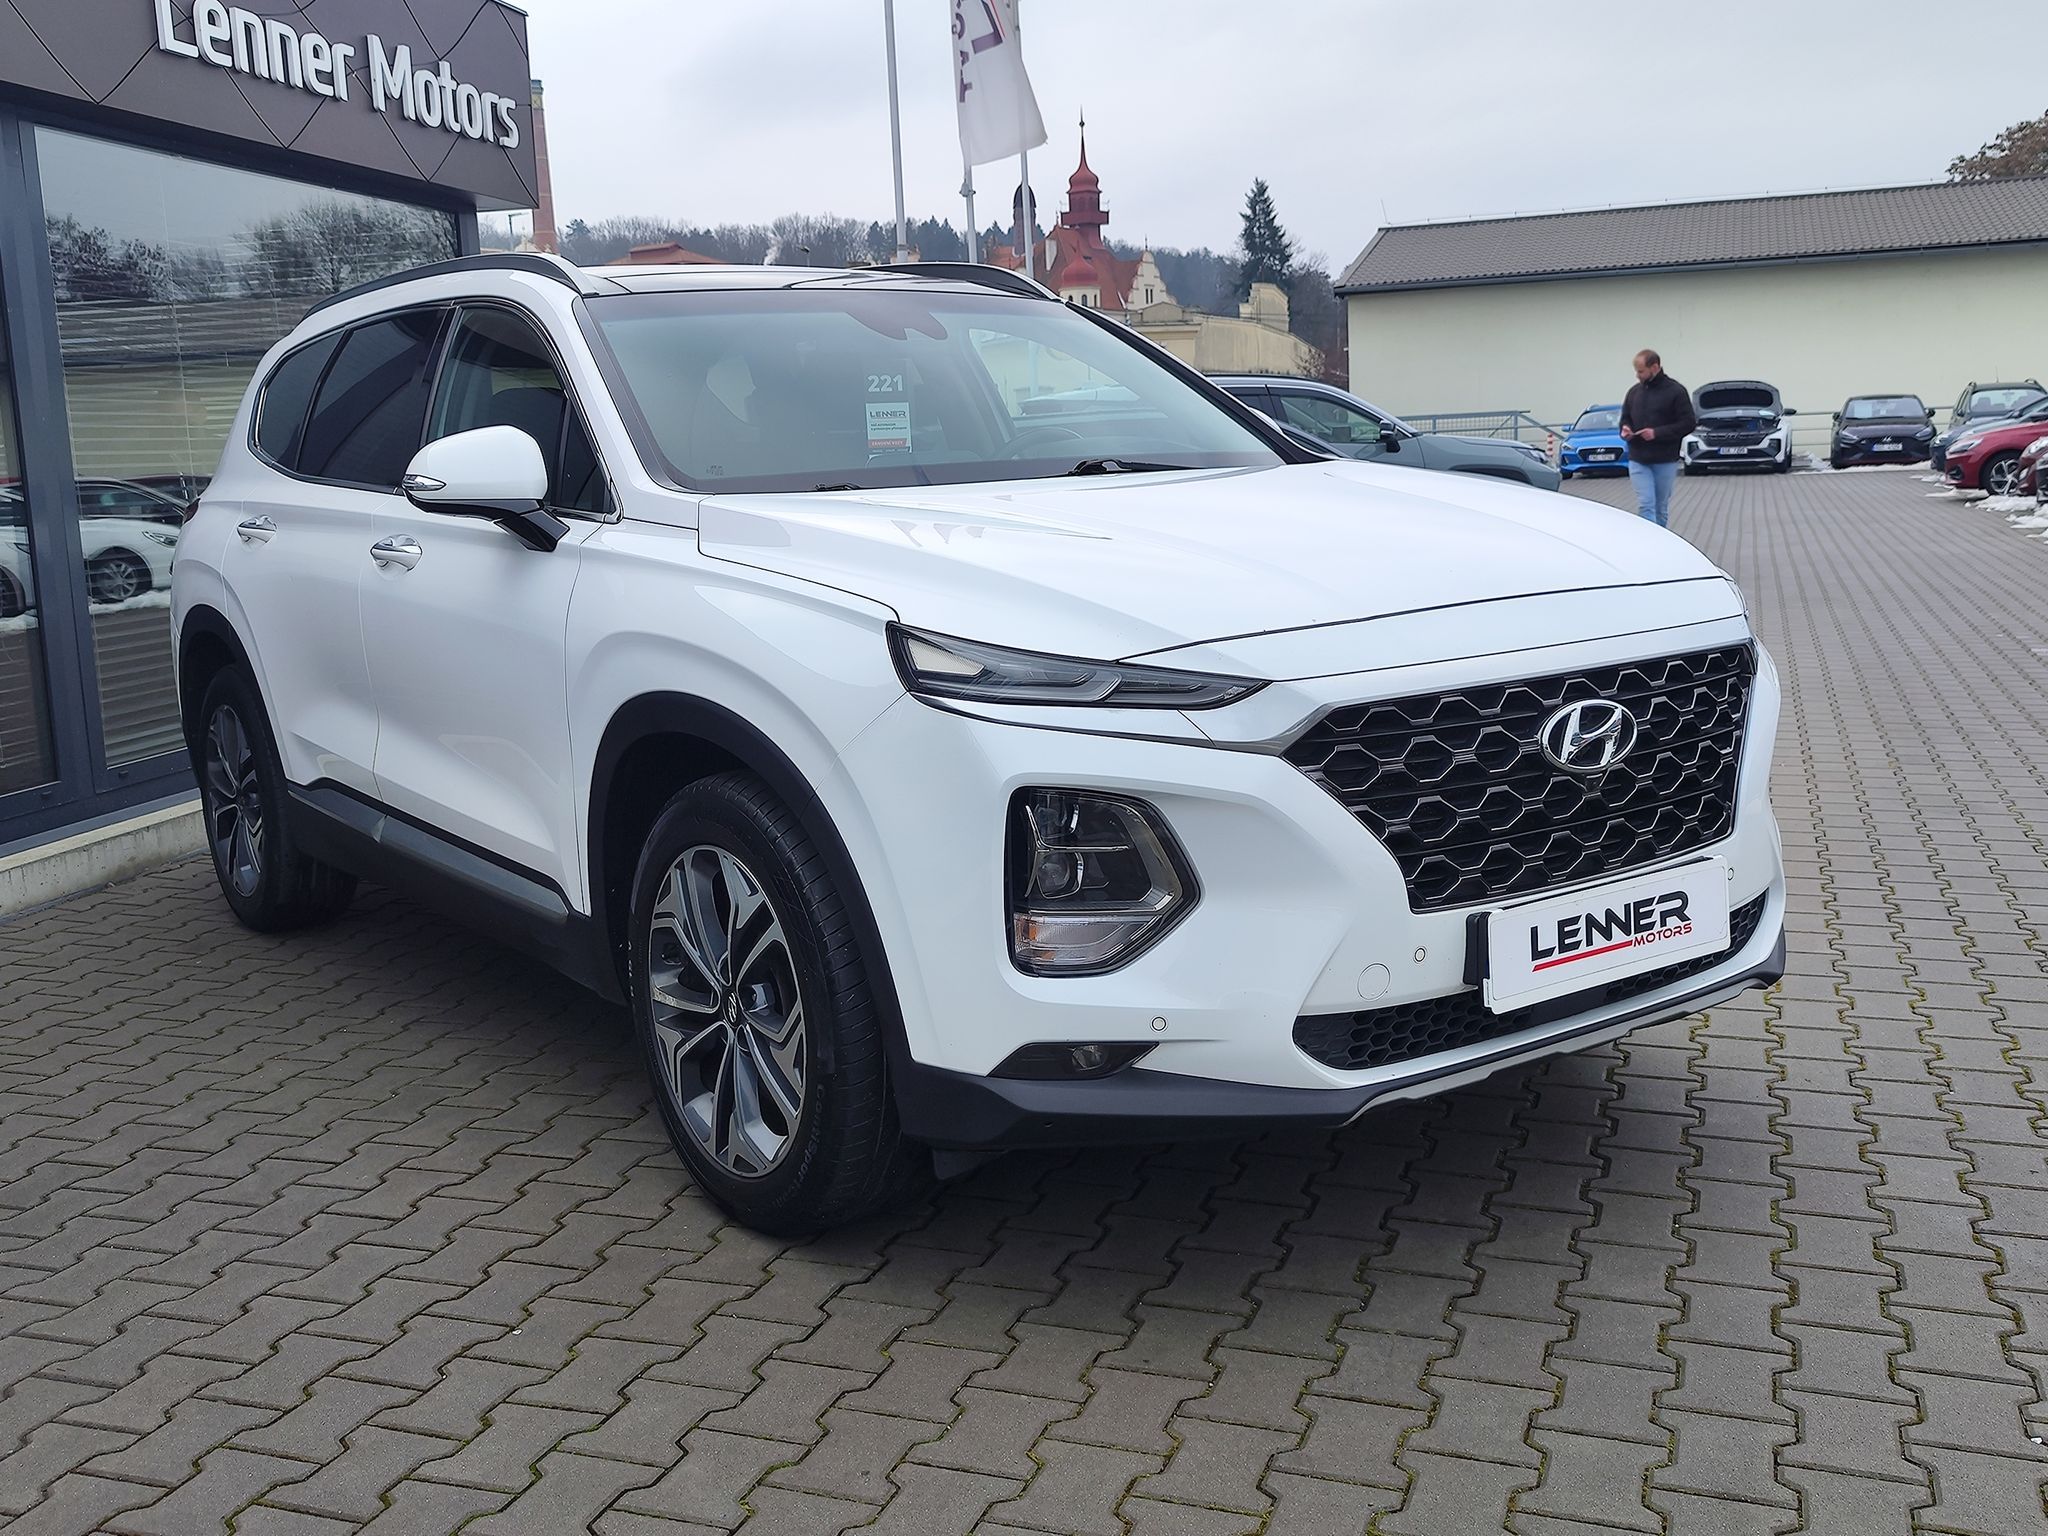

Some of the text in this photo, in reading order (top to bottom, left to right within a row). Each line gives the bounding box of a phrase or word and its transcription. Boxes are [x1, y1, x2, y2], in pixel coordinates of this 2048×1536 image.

[155, 0, 520, 149] Lenner Motors
[867, 374, 904, 392] 221
[869, 410, 907, 418] LENNER
[1530, 890, 1692, 962] LENNER
[1633, 921, 1693, 947] MOTORS
